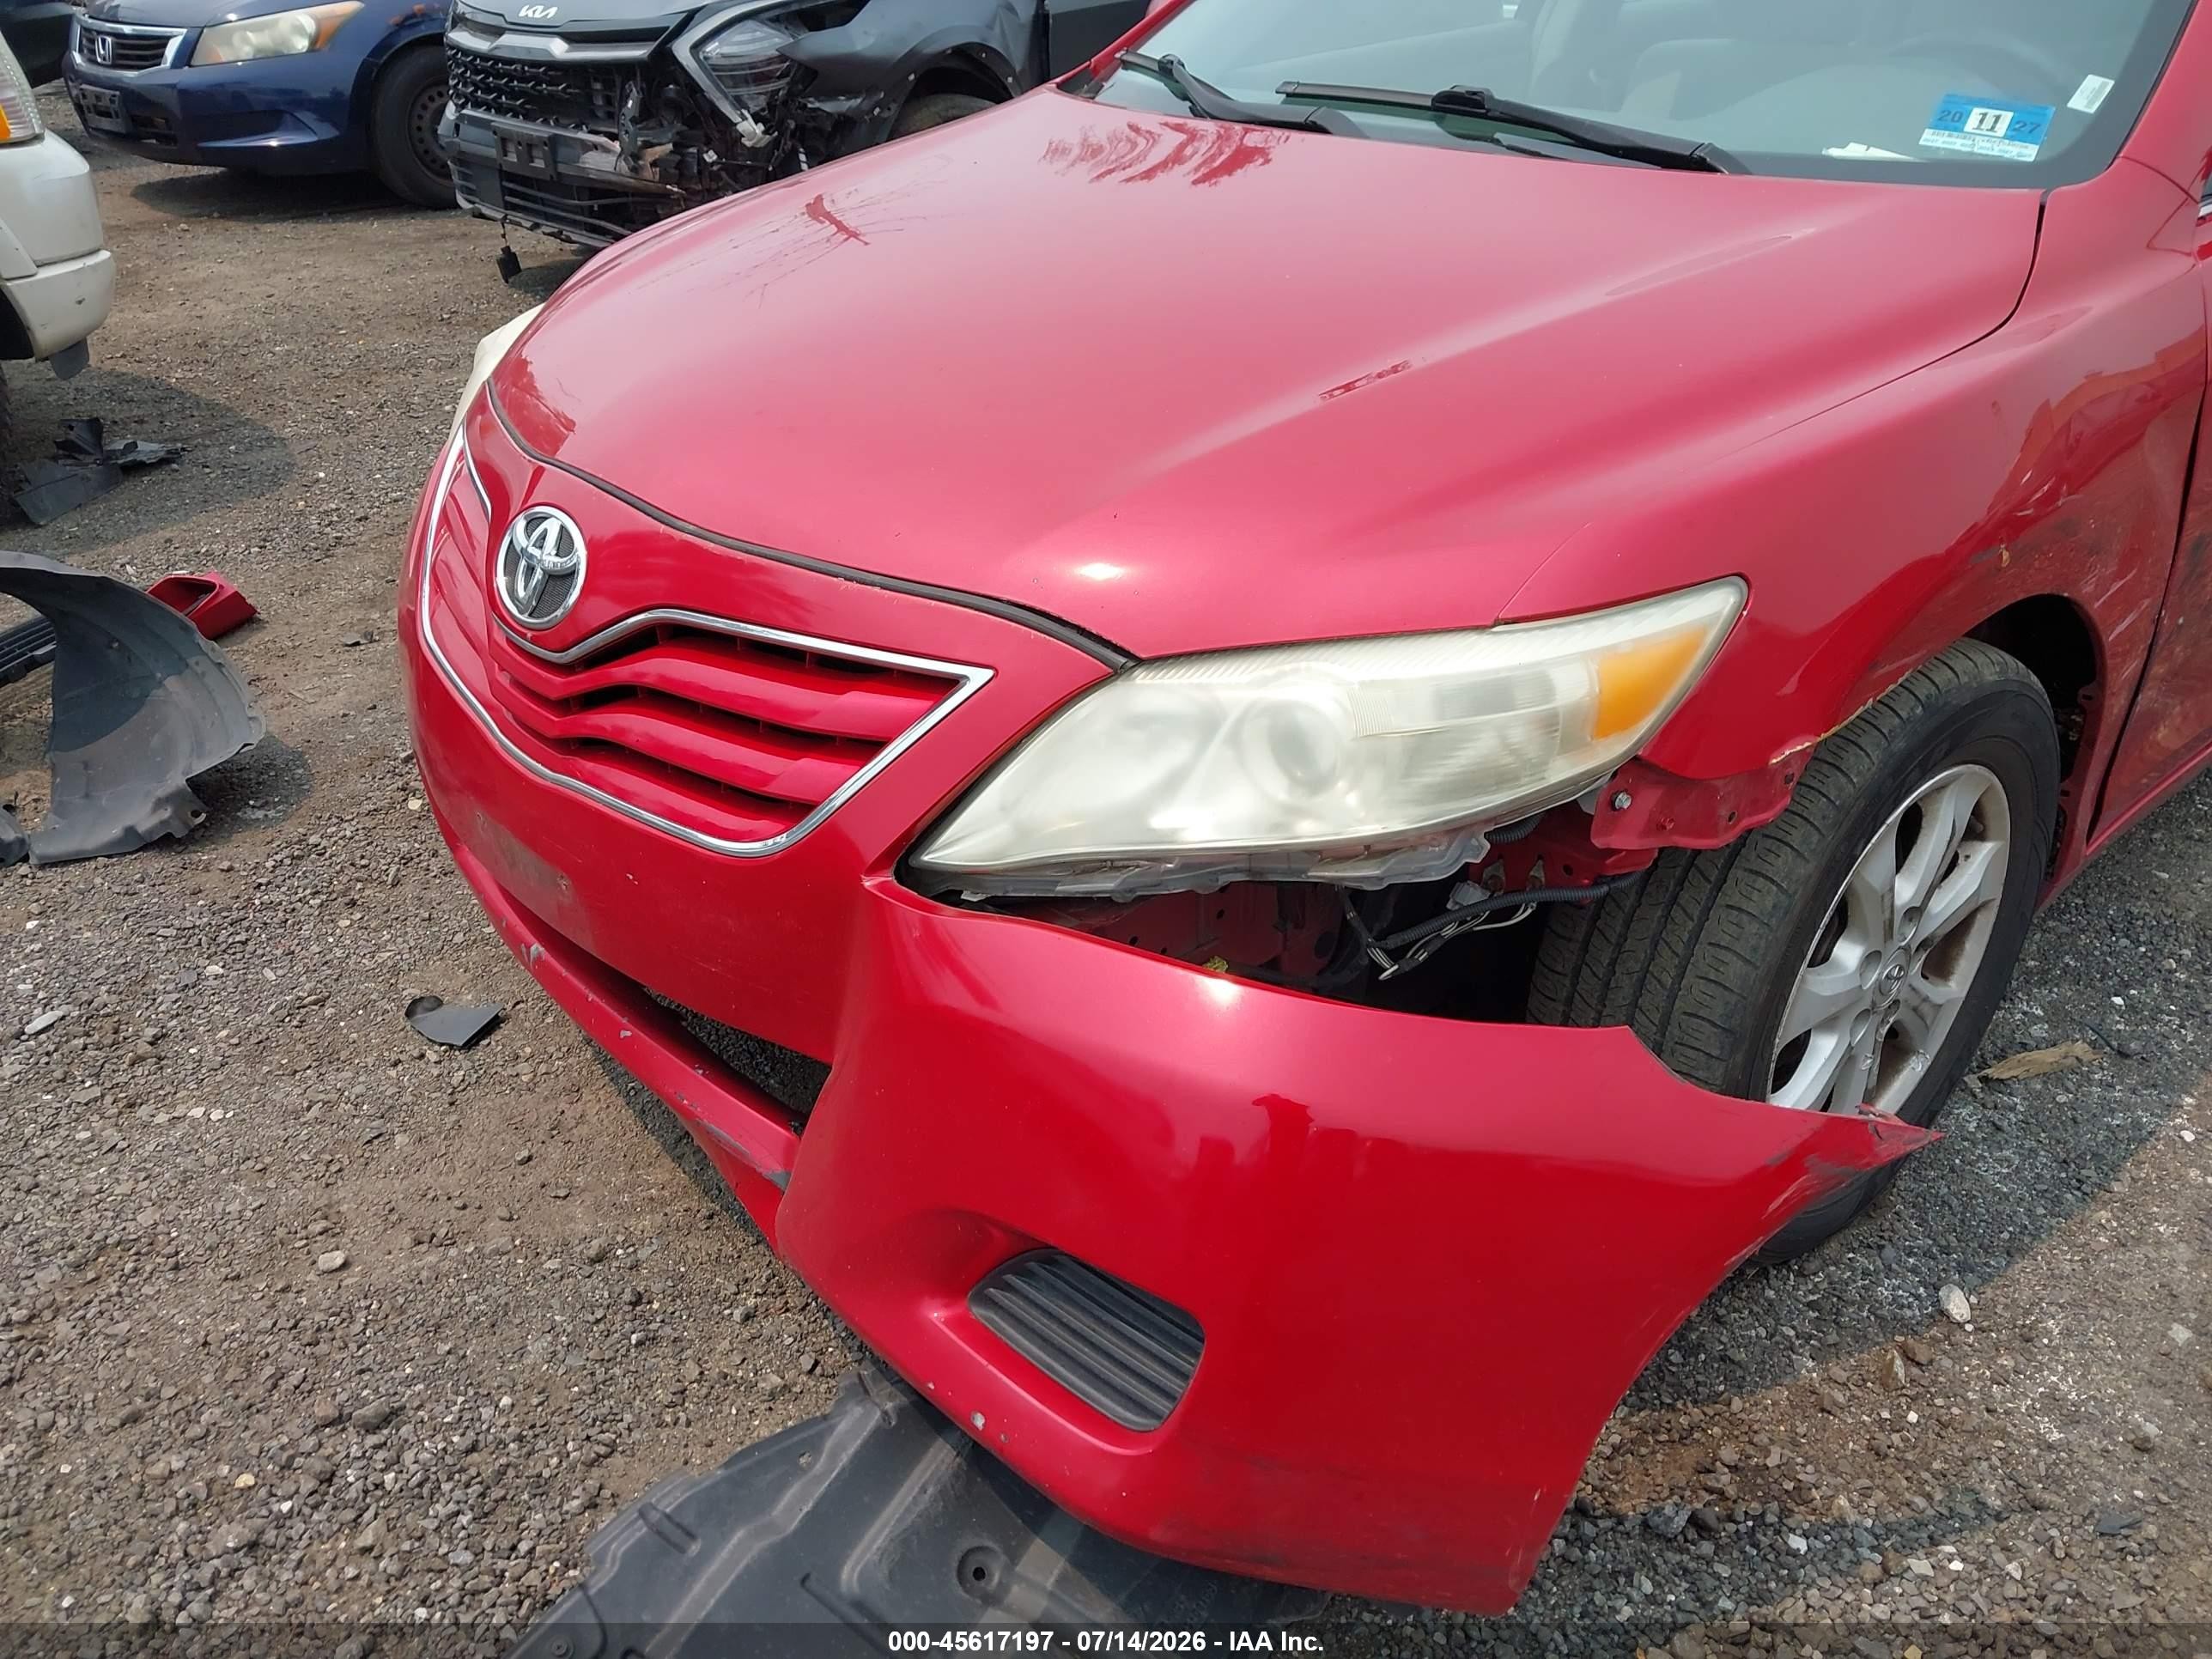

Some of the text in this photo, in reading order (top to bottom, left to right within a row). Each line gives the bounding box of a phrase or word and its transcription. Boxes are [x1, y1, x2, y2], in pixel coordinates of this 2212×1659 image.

[1937, 109, 2041, 134] 20 11 27
